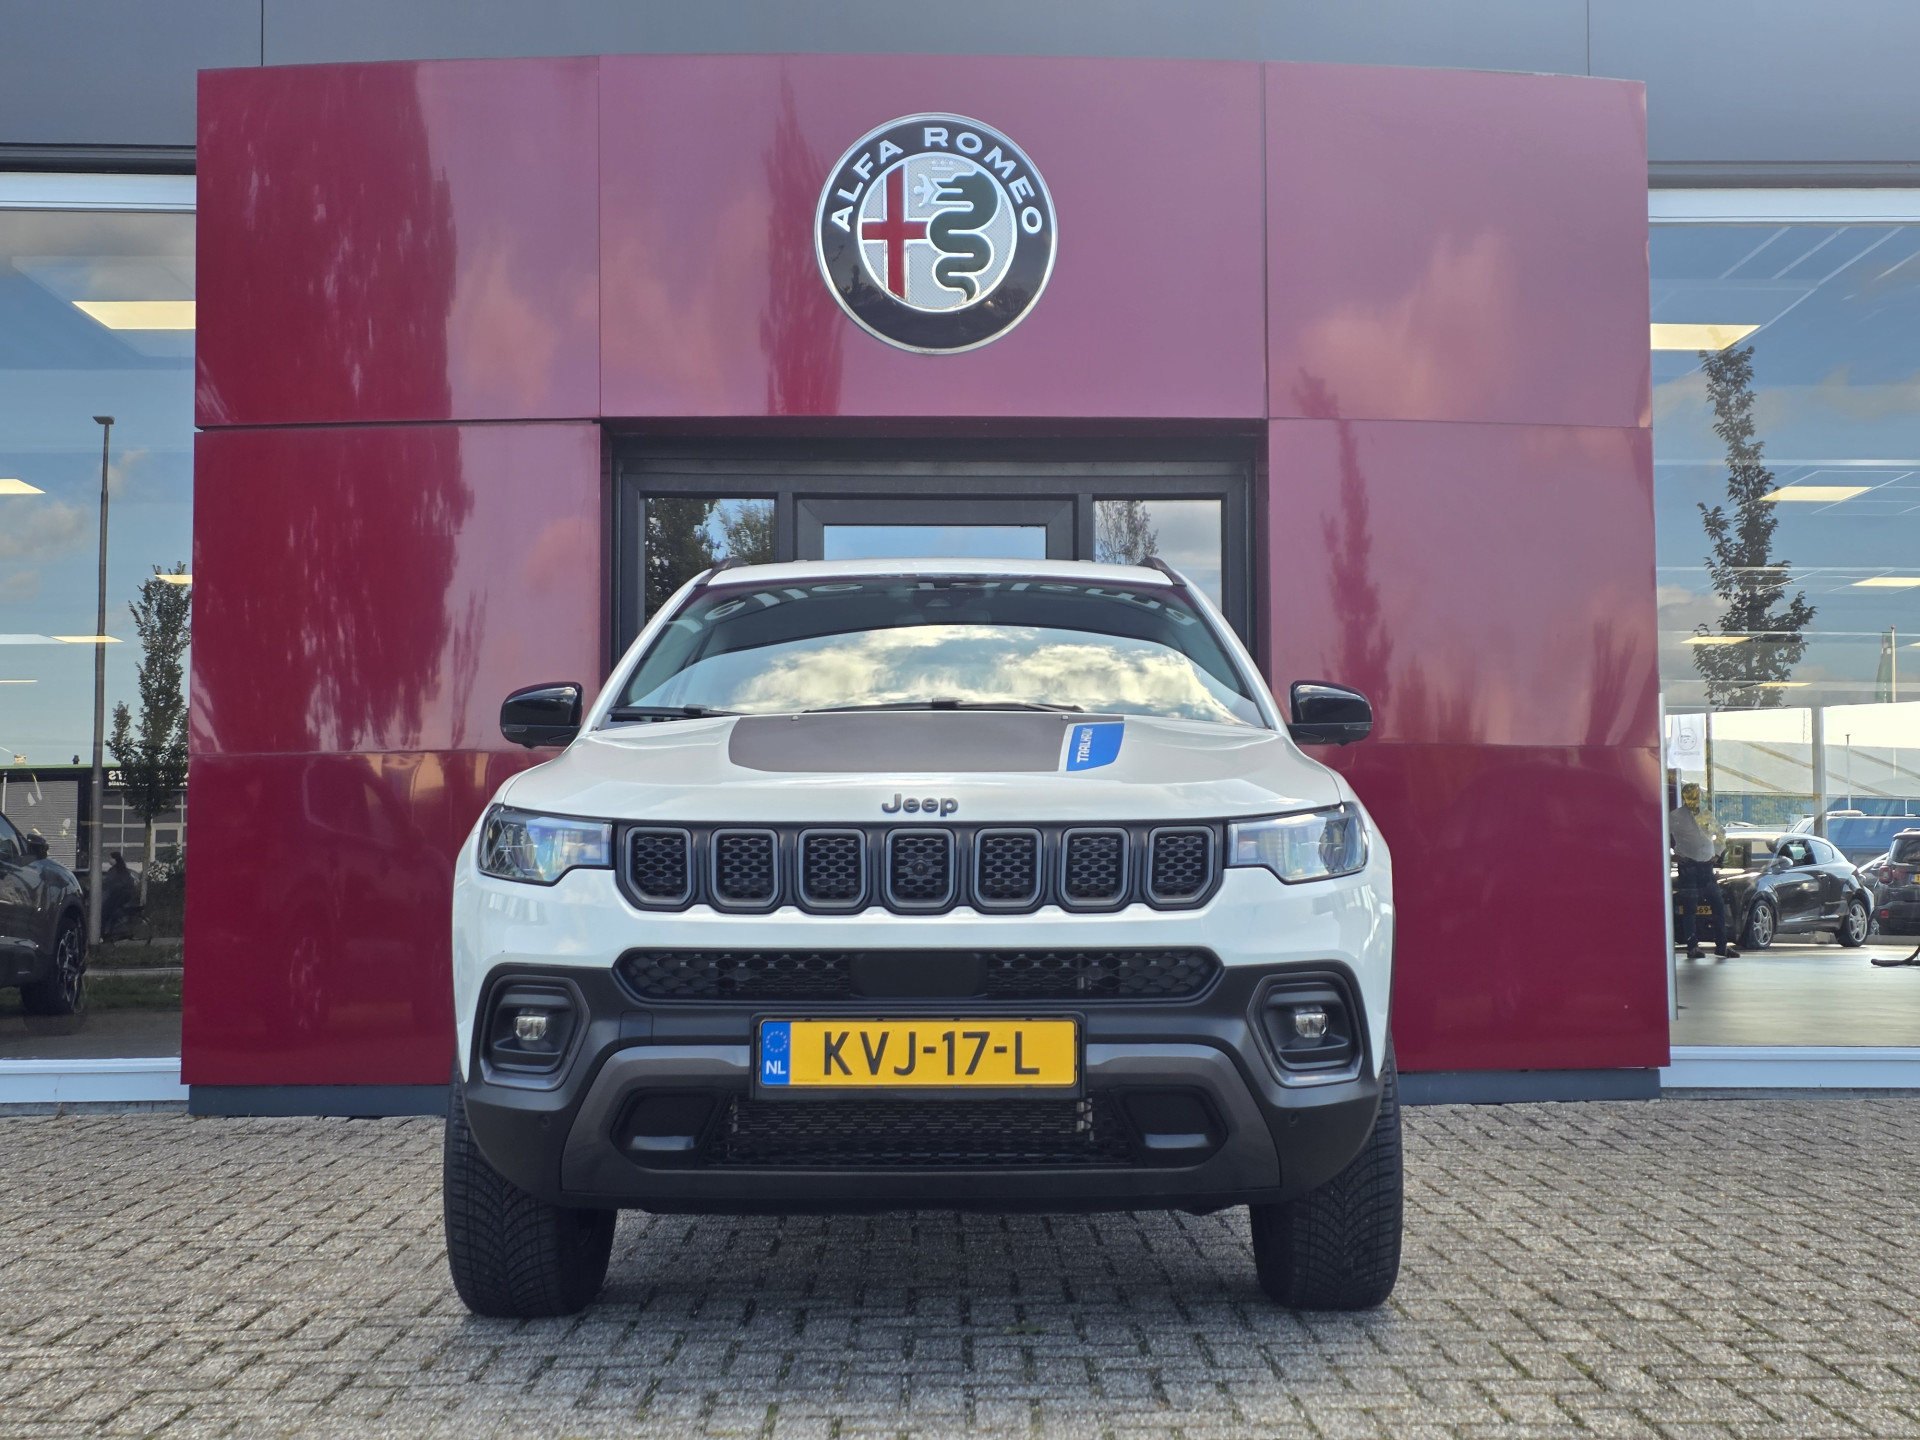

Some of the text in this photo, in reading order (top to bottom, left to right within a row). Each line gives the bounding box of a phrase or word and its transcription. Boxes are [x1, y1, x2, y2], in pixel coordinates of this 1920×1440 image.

[831, 127, 1043, 235] ALFA ROMEO
[881, 793, 959, 817] Jeep
[765, 1060, 786, 1075] NL
[823, 1031, 1040, 1076] KVJ-17-L
